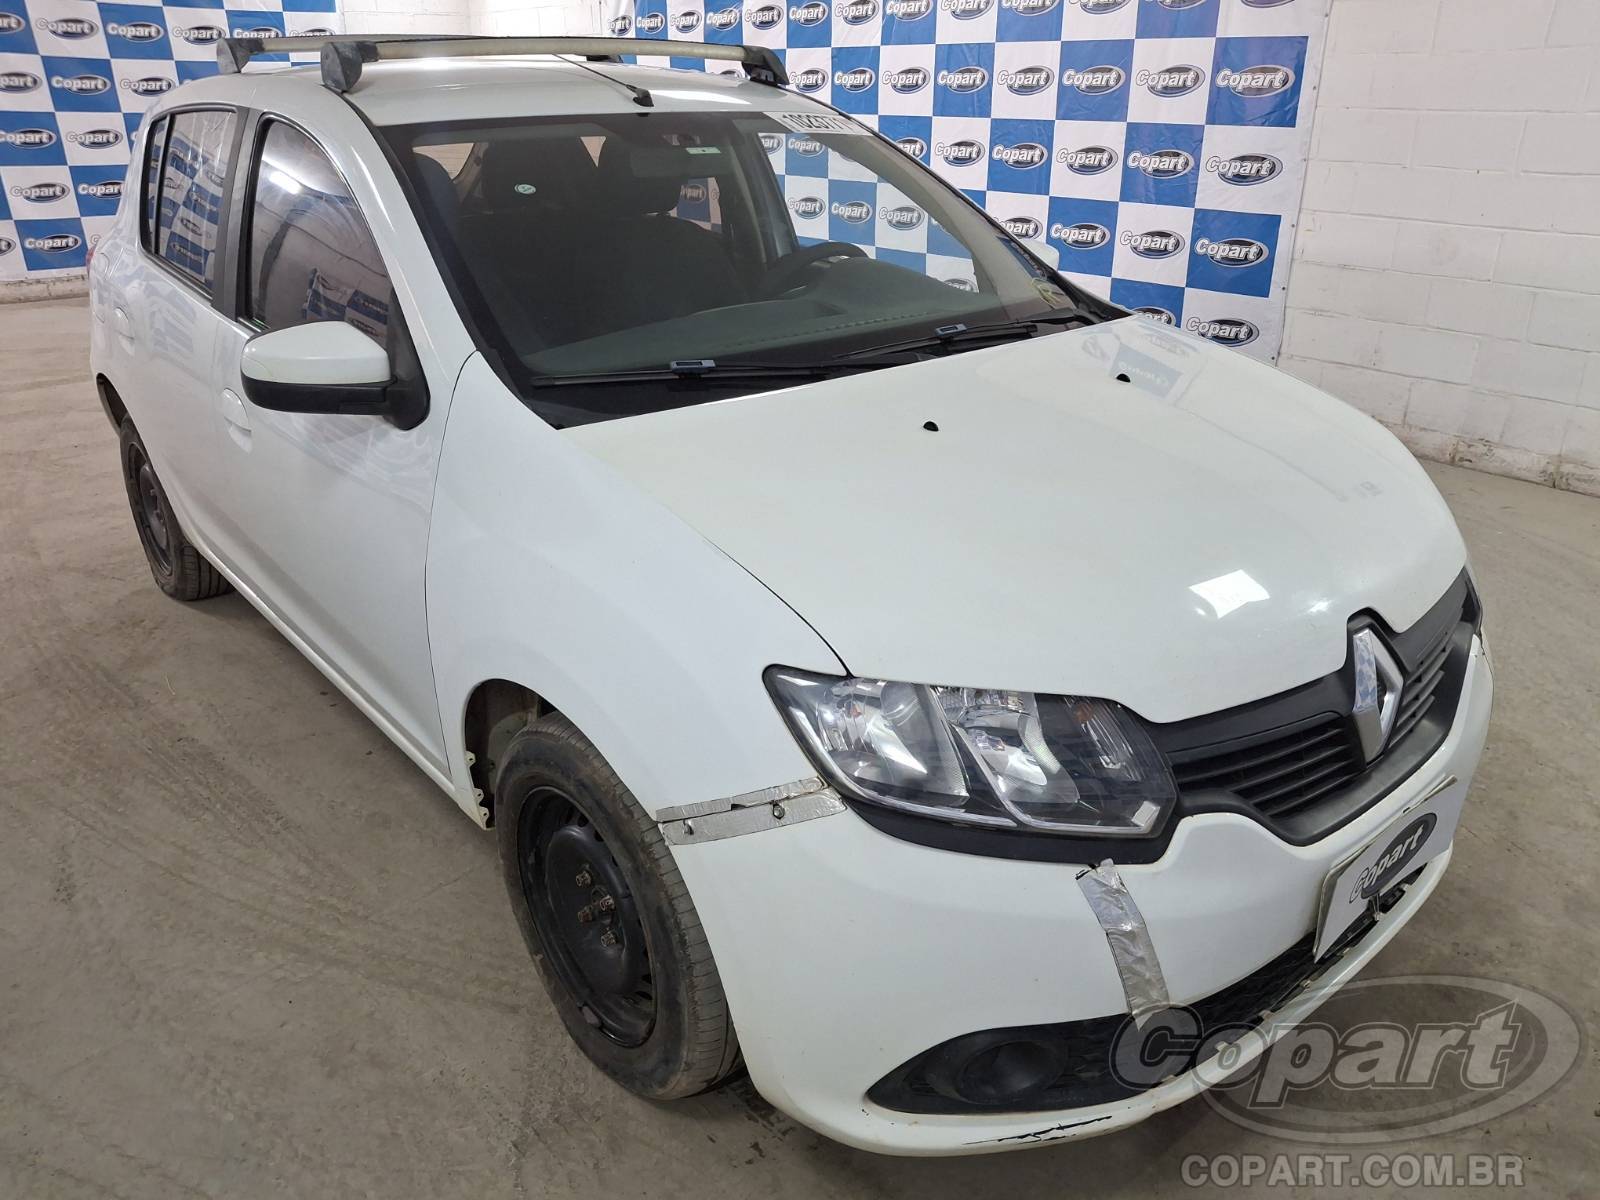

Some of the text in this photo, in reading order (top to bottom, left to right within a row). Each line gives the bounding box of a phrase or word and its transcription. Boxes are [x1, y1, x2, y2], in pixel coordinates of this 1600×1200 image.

[745, 9, 778, 22] Copart
[789, 6, 823, 23] Copart
[836, 3, 873, 18] Copart
[887, 0, 926, 16] Copart
[36, 18, 90, 33] Copart
[706, 11, 735, 26] Copart
[107, 23, 158, 36] Copart
[173, 26, 219, 38] Copart
[0, 76, 33, 89] part
[51, 76, 103, 89] Copart
[120, 79, 169, 91] Copart
[789, 71, 822, 87] Copart
[835, 71, 872, 87] Copart
[882, 71, 924, 86] Copart
[938, 70, 982, 87] Copart
[997, 70, 1046, 86] Copart
[1062, 69, 1117, 88] Copart
[1136, 69, 1195, 90] Copart
[1215, 68, 1285, 91] Copart
[66, 131, 115, 144] Copart
[935, 142, 978, 160] Copart
[992, 145, 1041, 163] Copart
[1056, 148, 1110, 167] Copart
[1128, 152, 1185, 171] Copart
[1206, 156, 1272, 177] Copart
[11, 186, 62, 199] Copart
[788, 197, 821, 213] Copart
[831, 202, 868, 219] Copart
[879, 207, 919, 224] Copart
[1050, 223, 1103, 243] Copart
[1120, 230, 1177, 251] Copart
[25, 237, 75, 251] Copart
[1195, 239, 1261, 260] Copart
[1186, 317, 1250, 339] Copart
[1350, 825, 1425, 904] Copart
